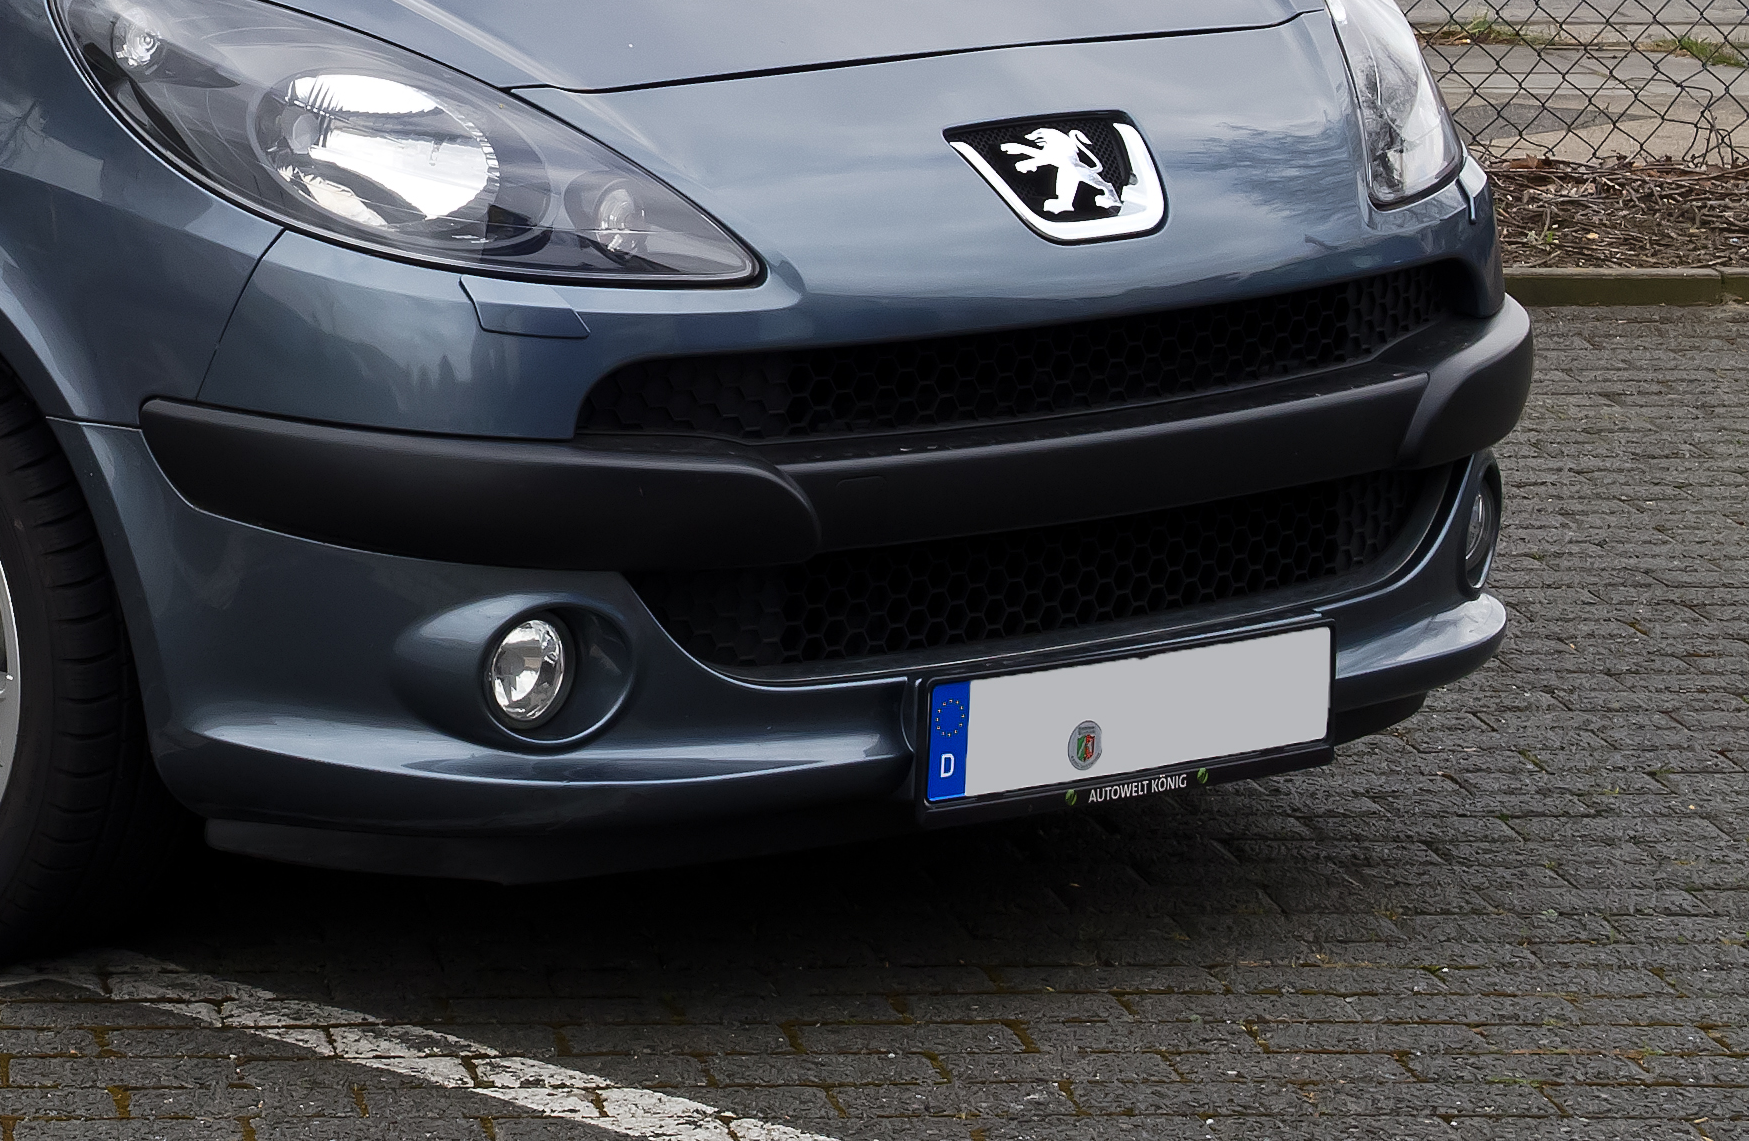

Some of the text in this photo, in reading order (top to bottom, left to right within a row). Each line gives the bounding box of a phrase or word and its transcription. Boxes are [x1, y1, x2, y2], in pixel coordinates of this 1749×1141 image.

[940, 753, 955, 778] D
[1088, 774, 1188, 803] AUTOWELT KÖNIG
